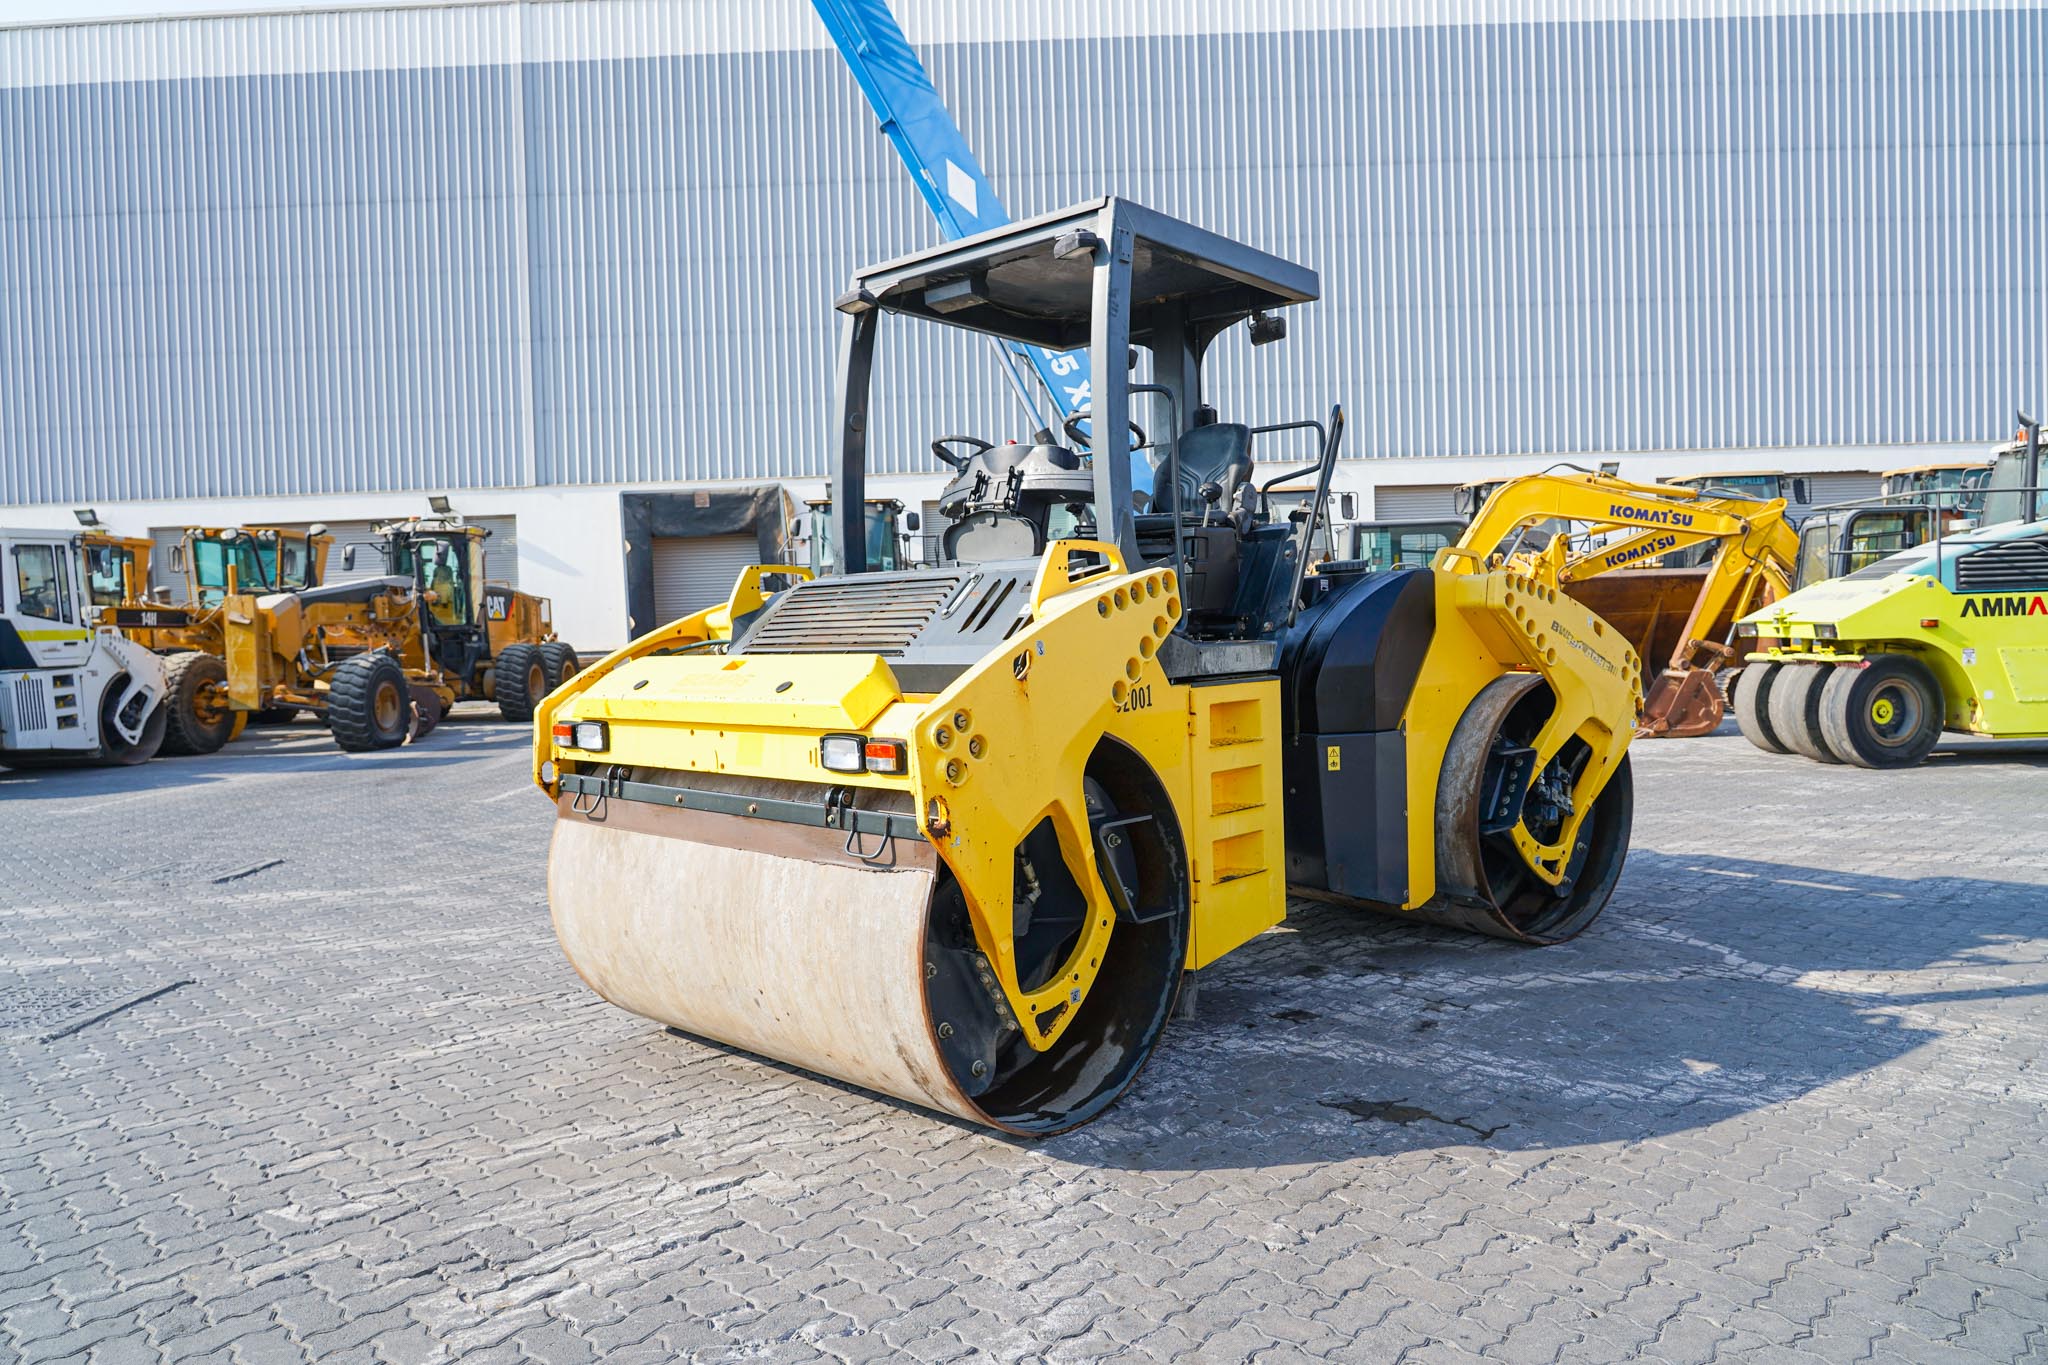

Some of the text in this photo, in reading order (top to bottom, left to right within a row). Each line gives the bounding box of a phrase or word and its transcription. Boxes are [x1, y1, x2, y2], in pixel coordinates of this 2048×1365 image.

[1609, 504, 1694, 527] KOMATSU
[1605, 534, 1676, 567] KOMATSU
[486, 595, 506, 619] CAT
